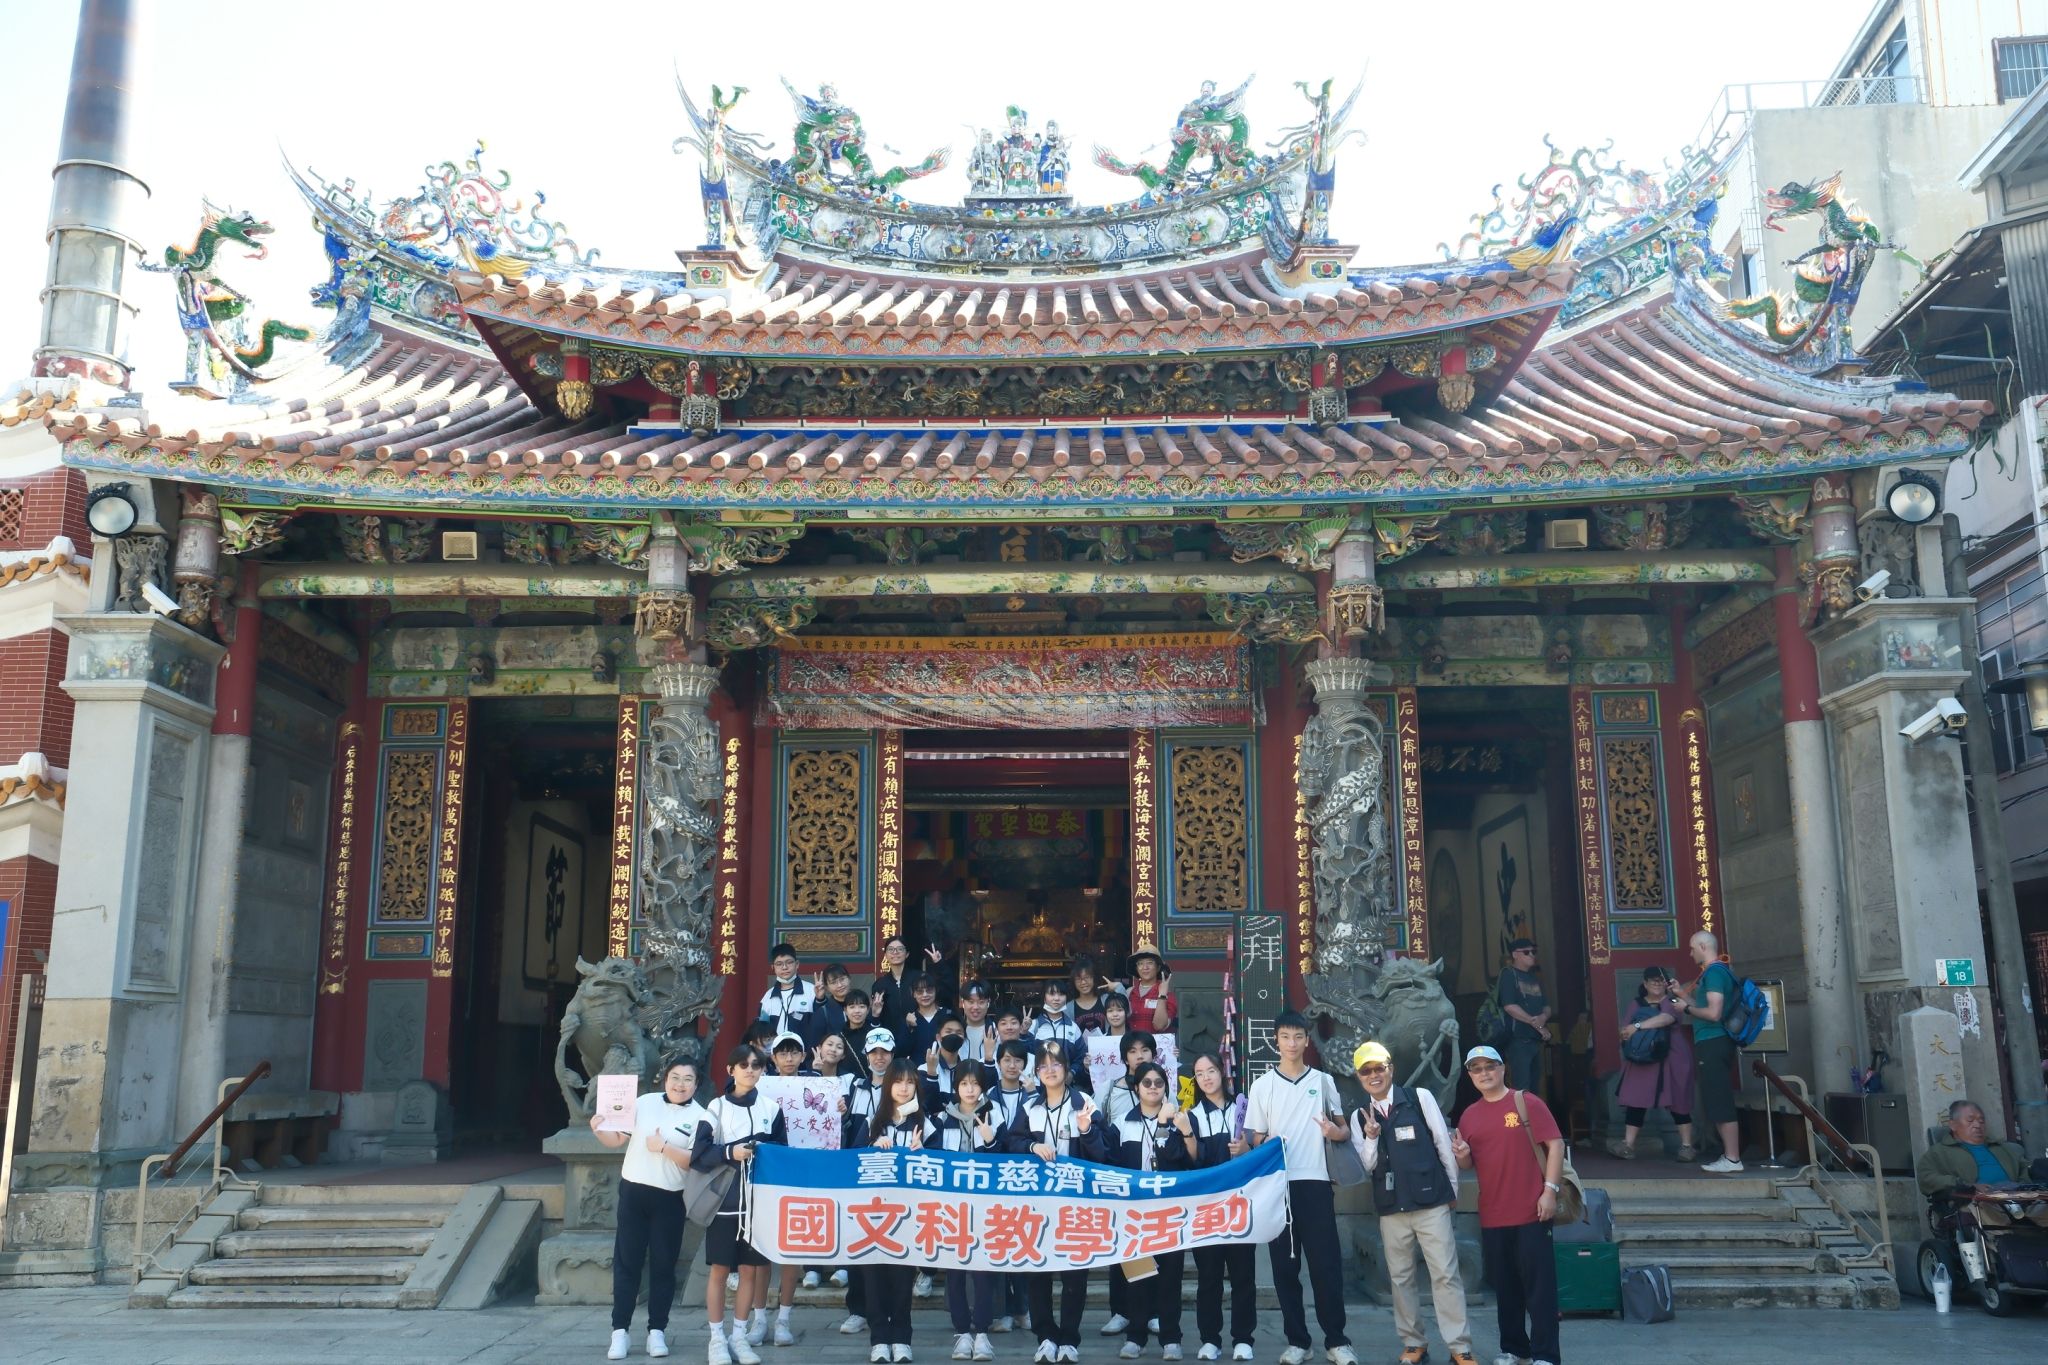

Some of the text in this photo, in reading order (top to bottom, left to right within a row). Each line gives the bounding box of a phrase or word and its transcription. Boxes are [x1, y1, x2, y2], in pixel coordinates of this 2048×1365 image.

[881, 729, 900, 973] 知有賴庇民衛國觚棱雄對
[1954, 971, 1967, 981] 18
[1093, 1053, 1123, 1066] 我愛
[857, 1151, 1177, 1197] 臺南市慈濟高中
[778, 1192, 1251, 1265] 國文科教學活動
